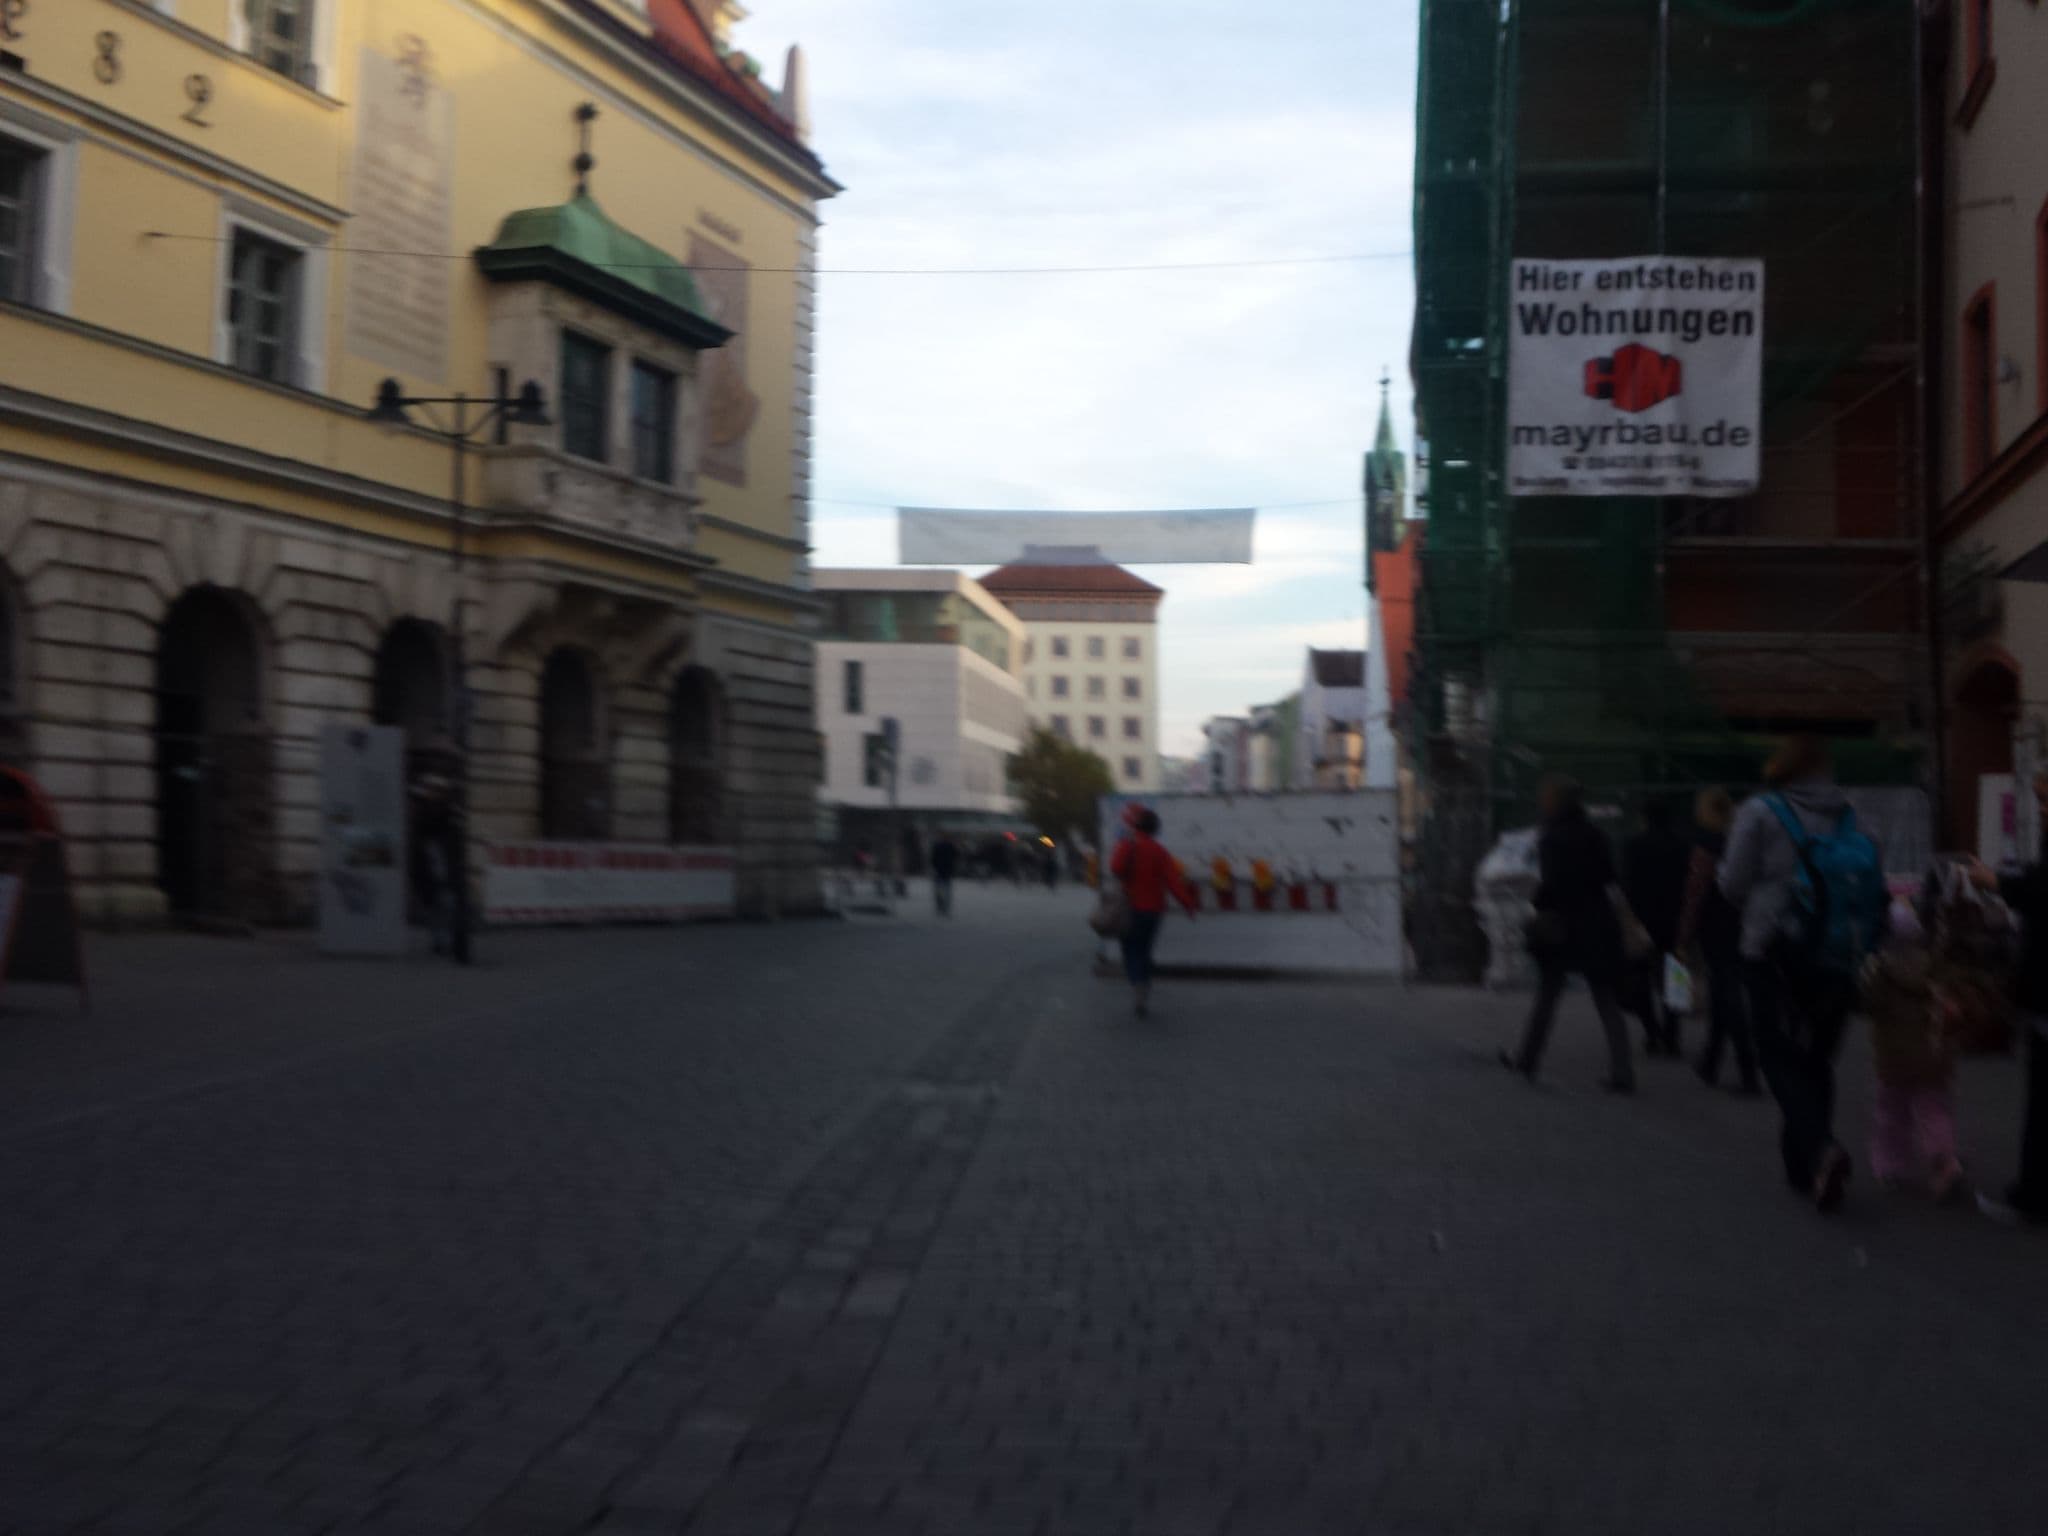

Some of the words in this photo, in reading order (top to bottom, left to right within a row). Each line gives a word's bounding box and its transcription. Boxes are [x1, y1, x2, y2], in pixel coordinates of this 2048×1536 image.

[1518, 265, 1583, 291] Hier
[1596, 264, 1756, 291] entstehen
[1518, 303, 1754, 343] Wohnungen
[1513, 418, 1751, 452] mayrbau.de
